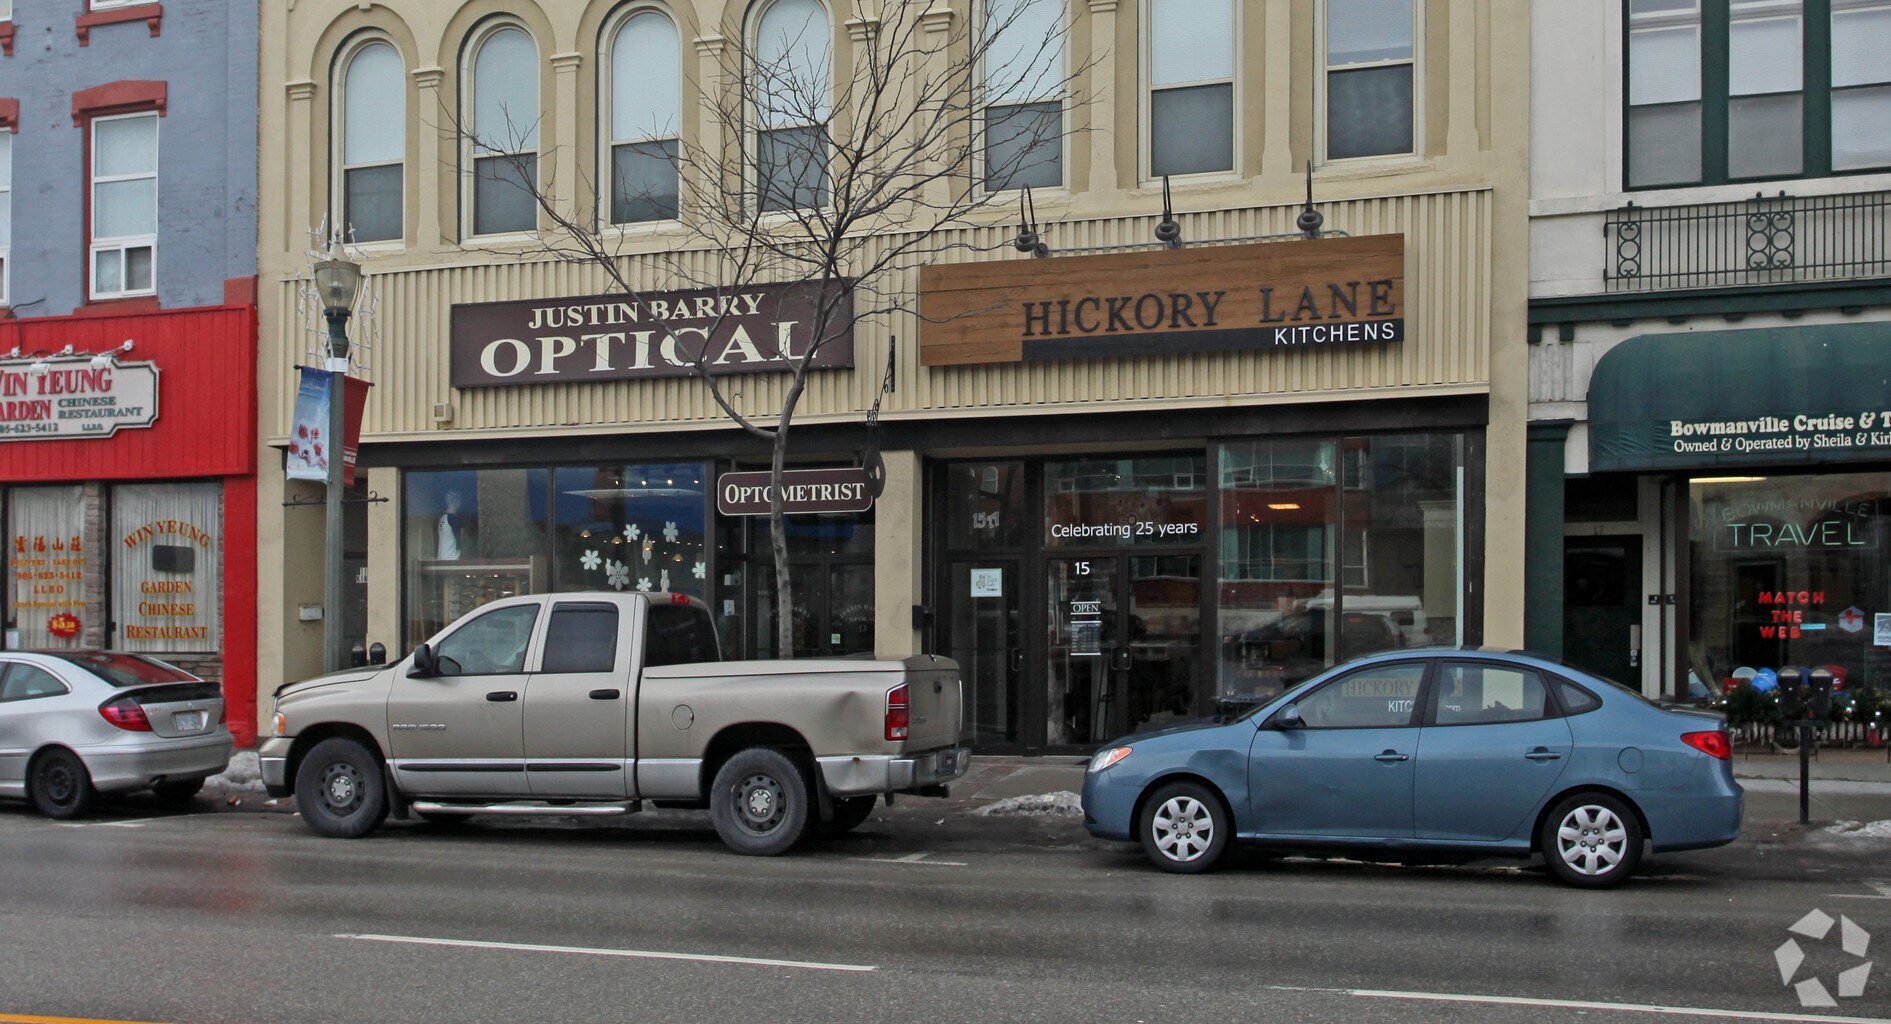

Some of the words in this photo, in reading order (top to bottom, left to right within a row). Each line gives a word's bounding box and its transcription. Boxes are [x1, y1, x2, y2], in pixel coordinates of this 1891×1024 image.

[528, 302, 638, 330] JUSTIN
[649, 293, 765, 323] BARRY
[1022, 291, 1226, 336] HICKORY
[1259, 279, 1395, 323] LANE
[1274, 322, 1395, 345] KITCHENS
[480, 320, 817, 378] OPTICAL
[0, 370, 28, 396] IN
[57, 396, 117, 408] CHINESE
[57, 407, 143, 419] RESTAURANT
[1670, 417, 1789, 436] Bowmanville
[1793, 413, 1854, 431] Cruise
[1859, 411, 1876, 429] &
[1674, 439, 1717, 453] Owned
[1720, 438, 1733, 451] &
[1735, 435, 1793, 453] Operated
[1796, 435, 1811, 450] by
[1814, 432, 1851, 447] Sheila
[1855, 432, 1868, 445] &
[1721, 498, 1871, 522] BOWMANVILLE
[124, 523, 153, 549] WIN
[156, 519, 210, 548] YEUNG
[1051, 523, 1131, 538] Celebrating
[1135, 522, 1154, 535] 25
[1158, 521, 1199, 537] years
[1727, 521, 1866, 547] TRAVEL
[1074, 562, 1090, 575] 15
[141, 581, 193, 594] GARDEN
[1758, 591, 1825, 604] MATCH
[138, 601, 194, 616] CHINESE
[1072, 603, 1099, 613] OPEN
[1771, 610, 1803, 623] THE
[126, 624, 207, 639] RESTAURANT
[1759, 626, 1801, 639] WEB
[1345, 680, 1414, 696] HICKORY
